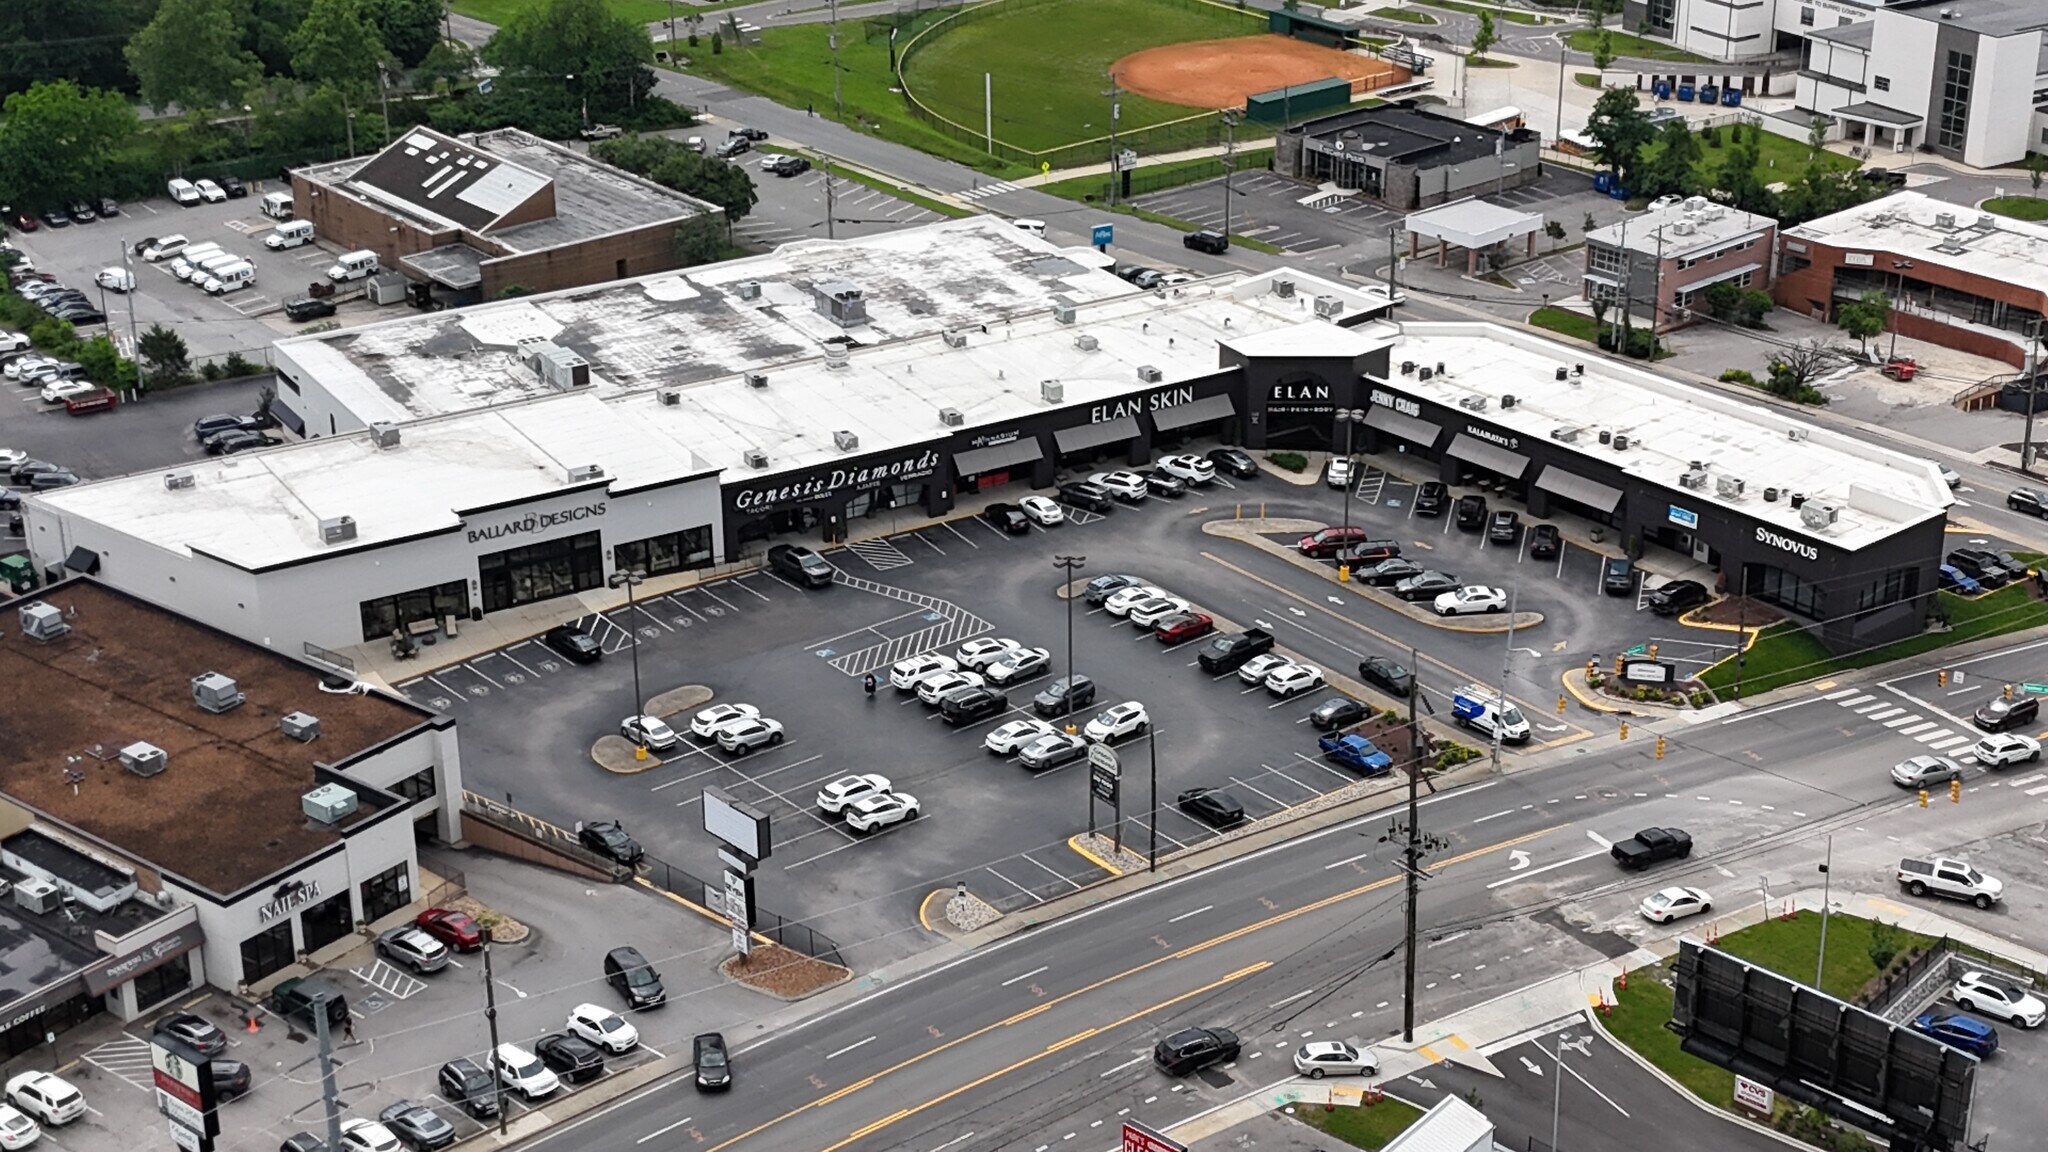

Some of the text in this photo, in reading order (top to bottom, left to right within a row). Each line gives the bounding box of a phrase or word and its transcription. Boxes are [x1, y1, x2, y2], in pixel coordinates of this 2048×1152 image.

[1091, 385, 1193, 424] ELAN SKIN
[1274, 385, 1329, 399] ELAN
[1370, 388, 1420, 417] JENNY CRAIG
[736, 449, 940, 509] Genesis Diamonds
[467, 502, 607, 543] BALLARD DESIGNS
[1755, 526, 1818, 561] SYNOVUS
[260, 880, 321, 923] NAIL SPA
[13, 1004, 46, 1026] COFFEE
[1748, 1085, 1766, 1098] CVS
